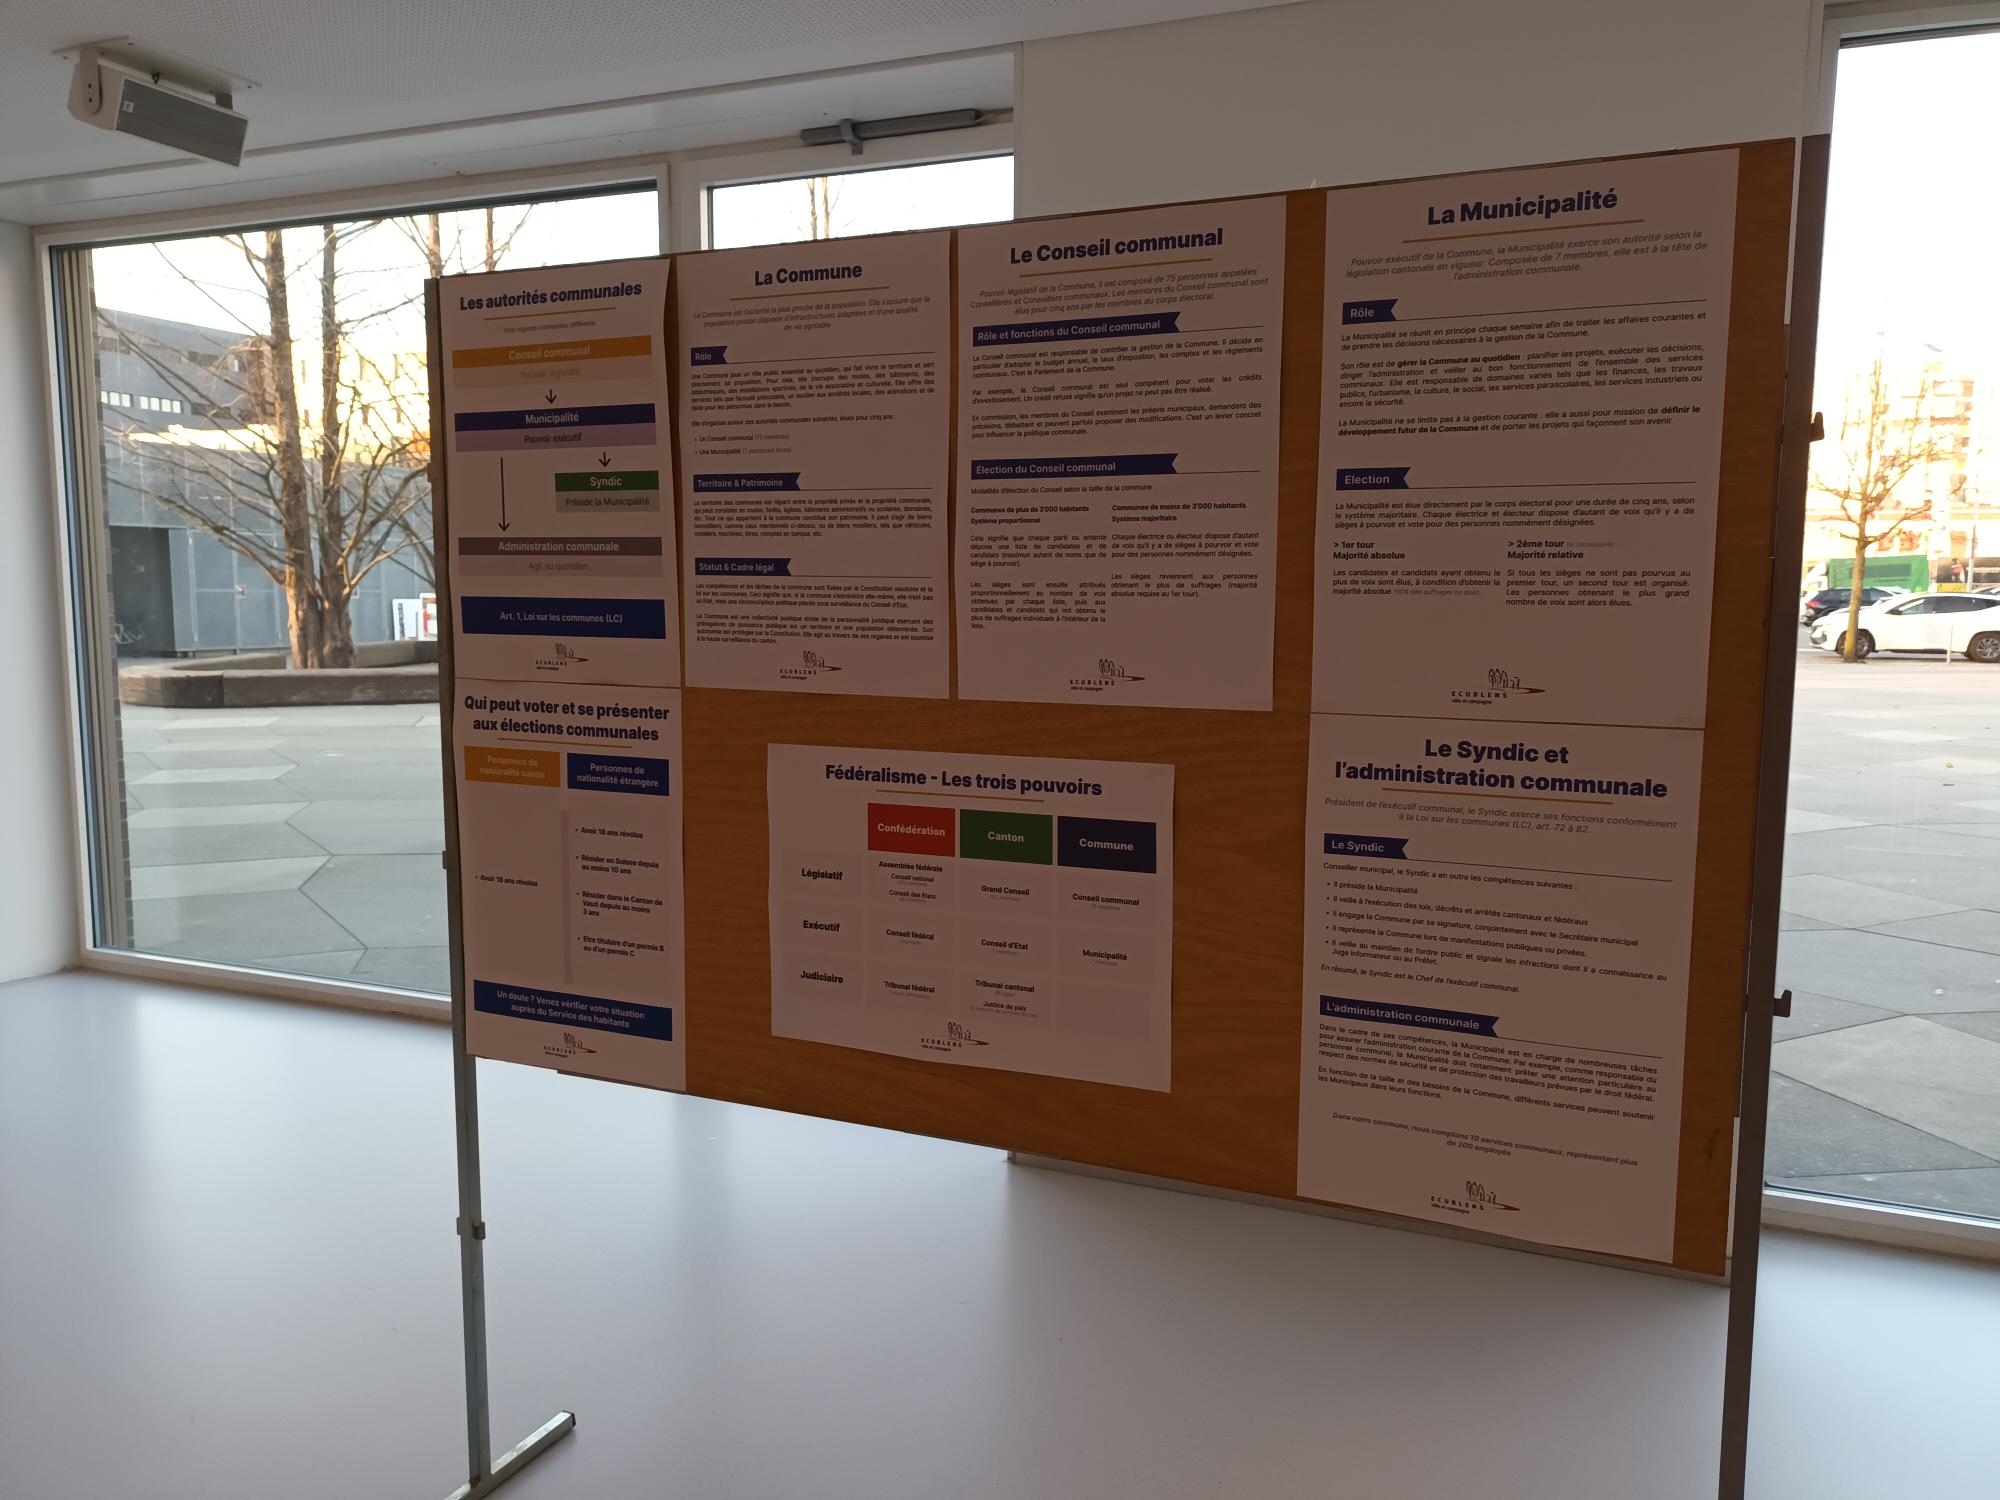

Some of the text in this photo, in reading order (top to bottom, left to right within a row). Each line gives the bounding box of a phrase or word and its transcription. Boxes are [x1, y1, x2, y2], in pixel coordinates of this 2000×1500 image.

[1427, 188, 1617, 225] La Municipalité
[1010, 228, 1222, 264] Le Conseil communal
[754, 266, 862, 285] La Commune
[460, 282, 642, 310] Les autorités communales
[1350, 306, 1374, 318] Rôle
[977, 318, 1160, 341] Rôle et fonctions du Conseil communal
[508, 343, 590, 361] Conseil communal
[694, 351, 711, 361] Rôle
[525, 410, 579, 425] Municipalité
[524, 431, 581, 444] Pouvoir exécutif
[976, 461, 1115, 475] Élection du Conseil communal
[589, 474, 622, 489] Syndic
[697, 477, 783, 488] Territoire & Patrimoine
[1344, 473, 1389, 485] Election
[565, 495, 650, 507] Préside la Municipalité
[1111, 501, 1246, 511] Communes de moins de 3'000 habitants
[1111, 513, 1177, 523] Système majoritaire
[498, 540, 619, 552] Administration communale
[1341, 539, 1355, 549] 1er
[1356, 540, 1375, 549] tour
[1516, 538, 1542, 548] 2ème
[1544, 539, 1564, 548] tour
[1332, 550, 1405, 561] Majorité absolue
[1507, 549, 1583, 561] Majorité relative
[698, 561, 774, 574] Statut & Cadre légal
[1506, 567, 1690, 579] Si tous les sièges ne sont pas pourvus au
[500, 610, 622, 624] Art. 1, Loi sur les communes (LC)
[1451, 689, 1507, 699] ECUBLENS
[464, 695, 669, 719] Qui peut voter et se présenter
[472, 718, 658, 740] aux élections communales
[1425, 738, 1568, 763] Le Syndic et
[486, 754, 538, 767] Personnes de
[479, 766, 545, 779] nationalité suisse
[590, 761, 644, 775] Personnes de
[576, 773, 658, 788] nationalité étrangère
[825, 764, 926, 784] Fédéralisme
[941, 770, 972, 787] Les
[975, 773, 1016, 790] trois
[1020, 778, 1102, 795] pouvoirs
[1335, 762, 1667, 796] l'administration communale
[877, 822, 945, 836] Confédération
[987, 830, 1024, 843] Canton
[1079, 837, 1133, 851] Commune
[1331, 838, 1384, 853] Le Syndic
[801, 867, 842, 880] Législatif
[878, 860, 943, 873] Assemblée fédérale
[980, 883, 1029, 896] Grand Conseil
[1333, 879, 1418, 894] Il préside la Municipalité
[1072, 892, 1139, 906] Conseil communal
[802, 919, 840, 932] Exécutif
[886, 927, 934, 940] Conseil fédéral
[980, 937, 1028, 951] Conseil d'Etat
[1082, 948, 1127, 961] Municipalité
[800, 969, 843, 984] Judiciaire
[884, 979, 934, 993] Tribunal fédéral
[975, 978, 1034, 993] Tribunal cantonal
[496, 989, 644, 1019] Un doute ? Venez vérifier votre situation
[983, 1000, 1004, 1009] Justice
[1005, 1002, 1013, 1010] de
[1014, 1004, 1026, 1012] paix
[511, 1003, 629, 1028] auprès du Service des habitants
[1326, 1002, 1479, 1028] L'administration communale
